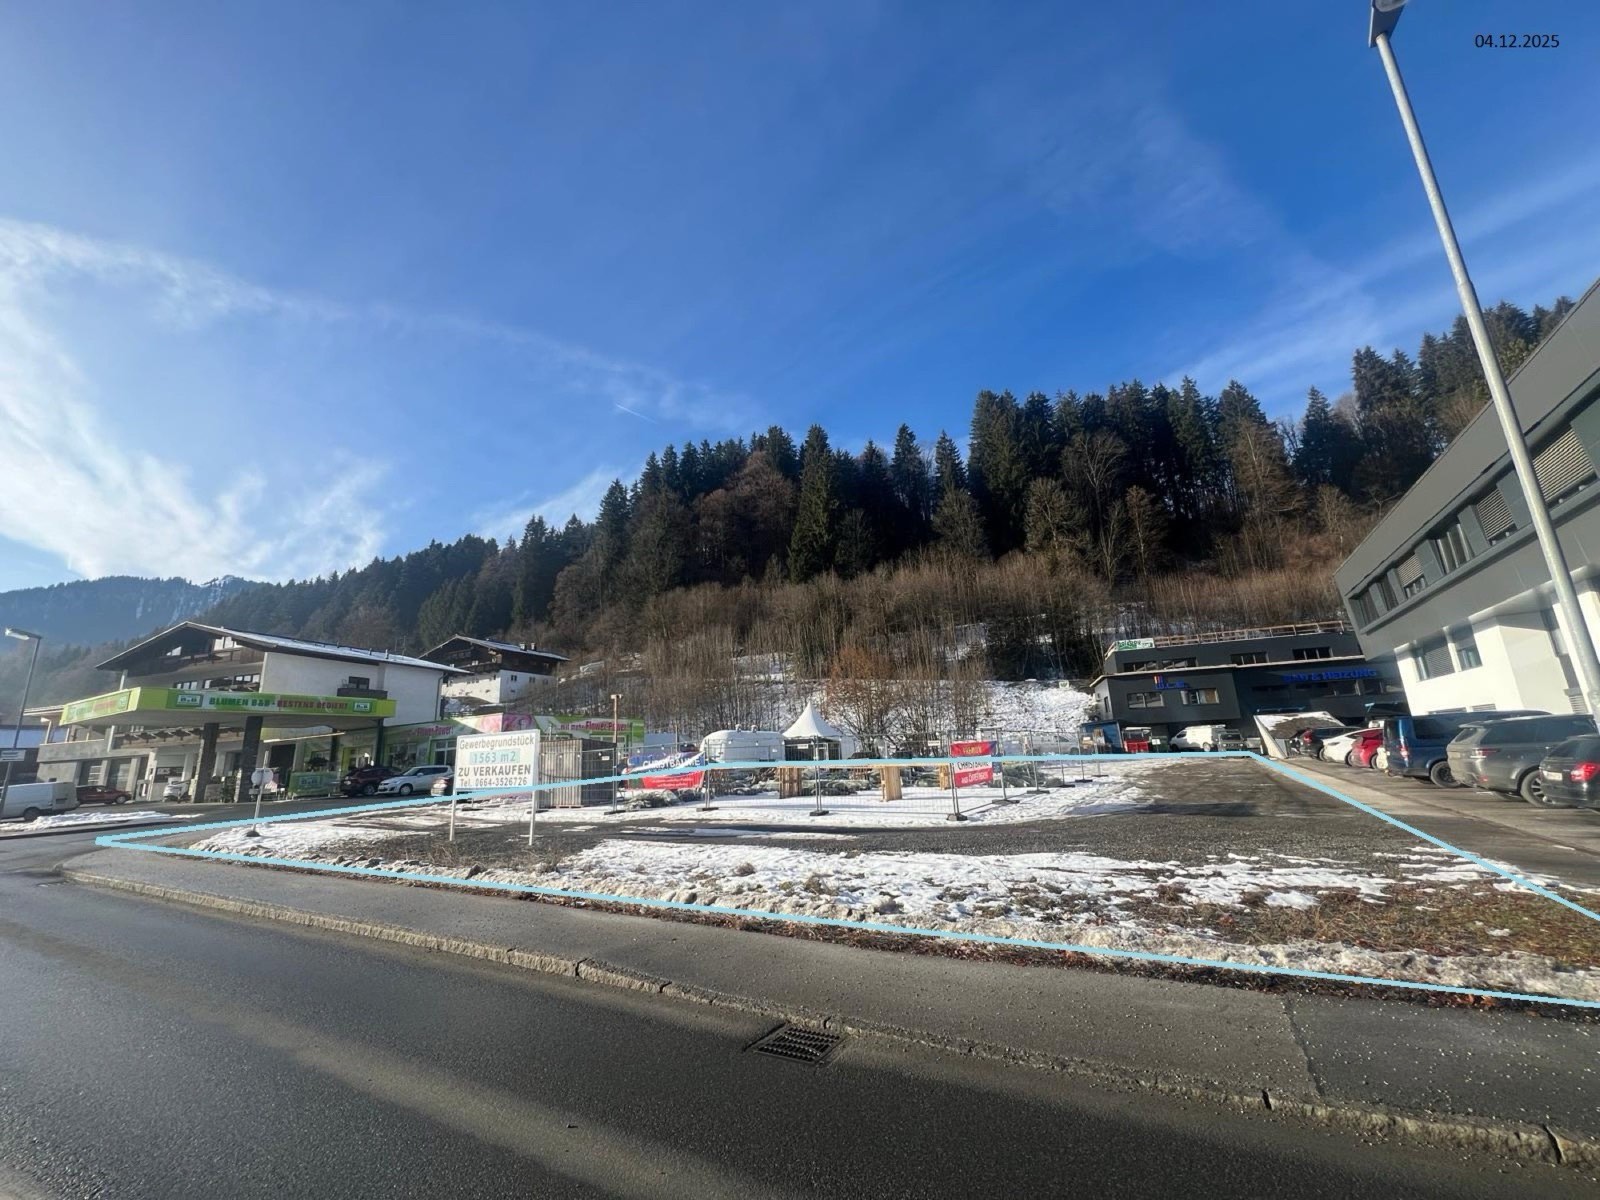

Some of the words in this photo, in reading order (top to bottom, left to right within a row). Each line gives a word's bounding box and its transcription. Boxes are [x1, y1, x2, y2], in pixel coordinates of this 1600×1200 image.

[209, 697, 249, 707] BLUMEN
[459, 735, 534, 750] Gewerbegrundstück
[474, 751, 497, 763] 1563
[501, 751, 516, 763] m2
[458, 767, 470, 777] ZU
[474, 765, 531, 777] VERKAUFEN
[461, 778, 473, 787] Tel.
[475, 777, 528, 787] 0664-3526726
